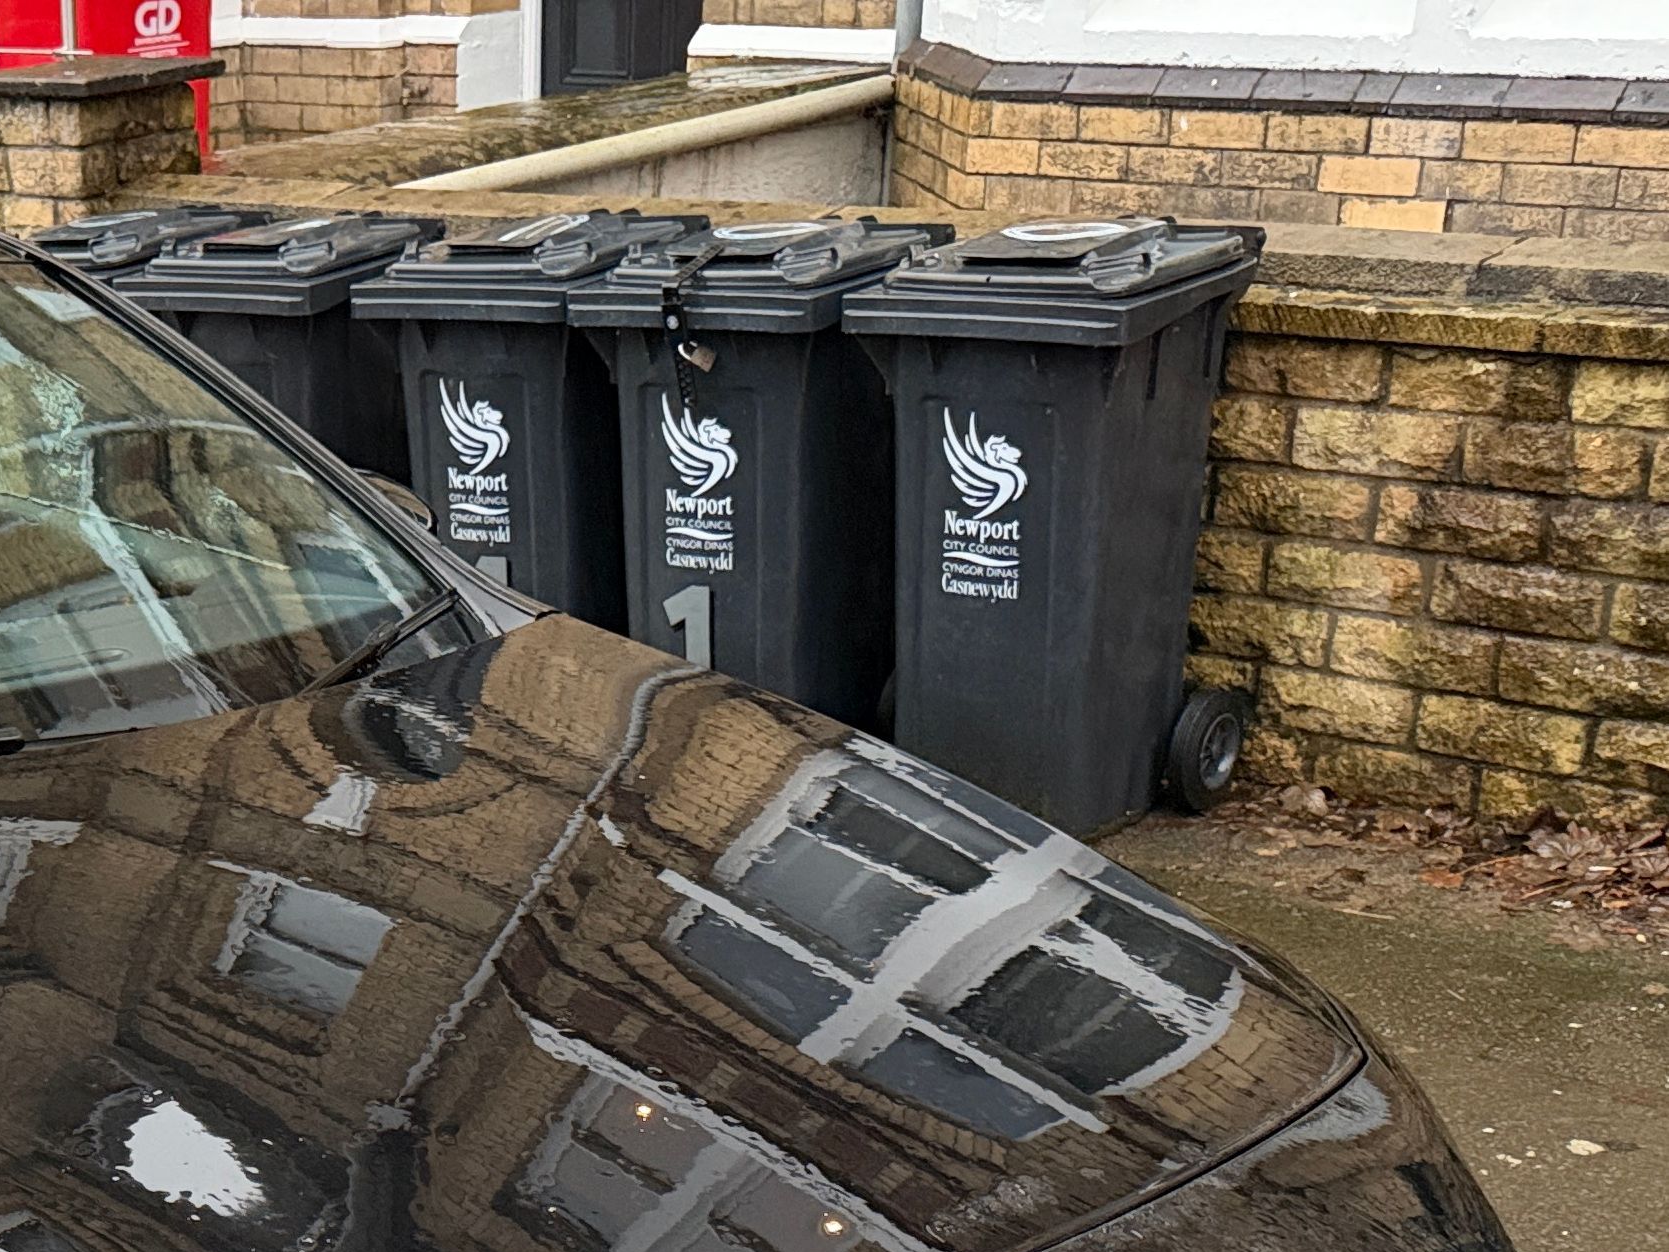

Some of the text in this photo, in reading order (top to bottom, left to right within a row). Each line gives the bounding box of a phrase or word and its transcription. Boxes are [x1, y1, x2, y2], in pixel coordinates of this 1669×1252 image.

[448, 467, 509, 495] Newport
[666, 488, 734, 519] Newport
[451, 522, 511, 547] Casnewydd
[666, 517, 732, 530] CITY COUNCIL
[944, 509, 1020, 543] Newport
[704, 541, 733, 551] DINAS
[943, 540, 1020, 557] CITY COUNCIL
[666, 547, 733, 574] Casnewydd
[942, 562, 1019, 578] CYNGOR DINAS
[942, 573, 1019, 603] Casnewydd
[662, 585, 711, 670] 1
